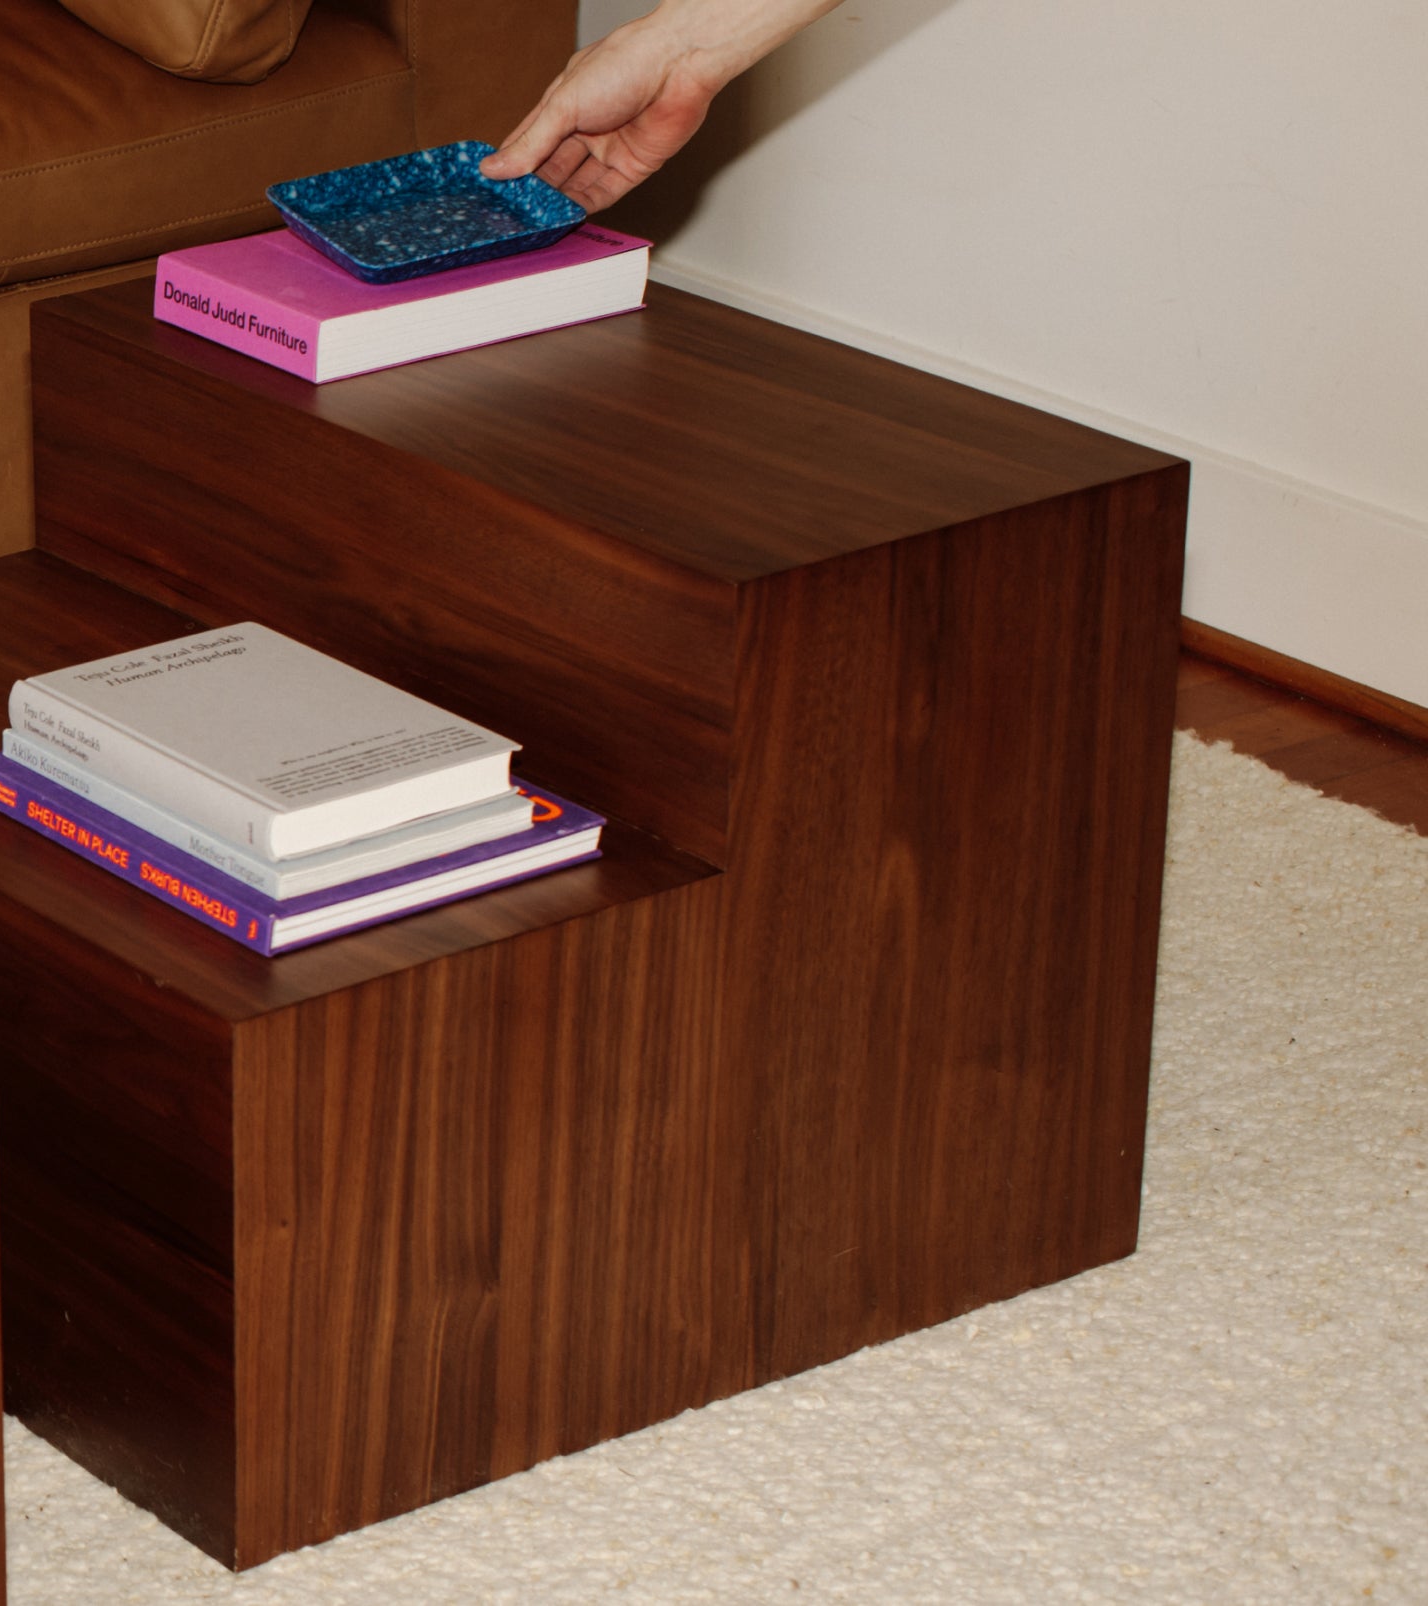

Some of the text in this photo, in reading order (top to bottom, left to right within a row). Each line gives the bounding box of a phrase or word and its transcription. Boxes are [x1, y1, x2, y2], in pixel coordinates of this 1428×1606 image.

[164, 281, 308, 355] Donald Judd Furniture
[106, 646, 247, 687] Human Archipelago
[110, 660, 147, 674] Cole
[150, 648, 192, 663] Fazal
[191, 634, 245, 651] Sheikh
[10, 742, 38, 767] Akiko
[27, 800, 130, 869] SHELTER IN PLACE
[139, 860, 238, 928] STEPHEN BURKS
